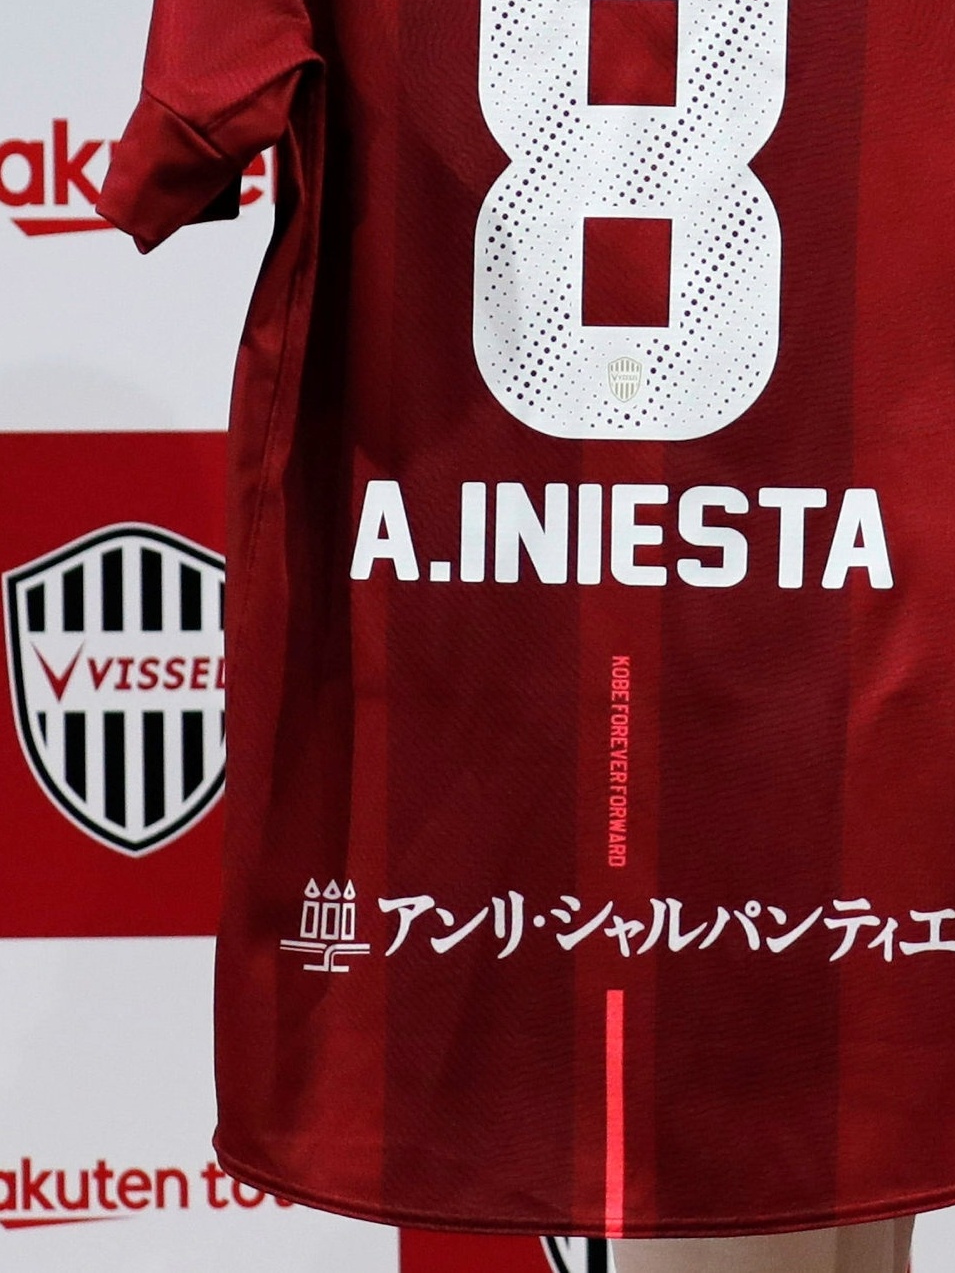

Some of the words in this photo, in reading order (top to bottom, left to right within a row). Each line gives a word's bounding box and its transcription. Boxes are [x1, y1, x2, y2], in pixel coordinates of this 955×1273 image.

[349, 480, 894, 590] A.INIESTA
[611, 655, 631, 702] KOBE
[610, 704, 629, 783] FOREVER
[608, 785, 628, 868] FORWARD
